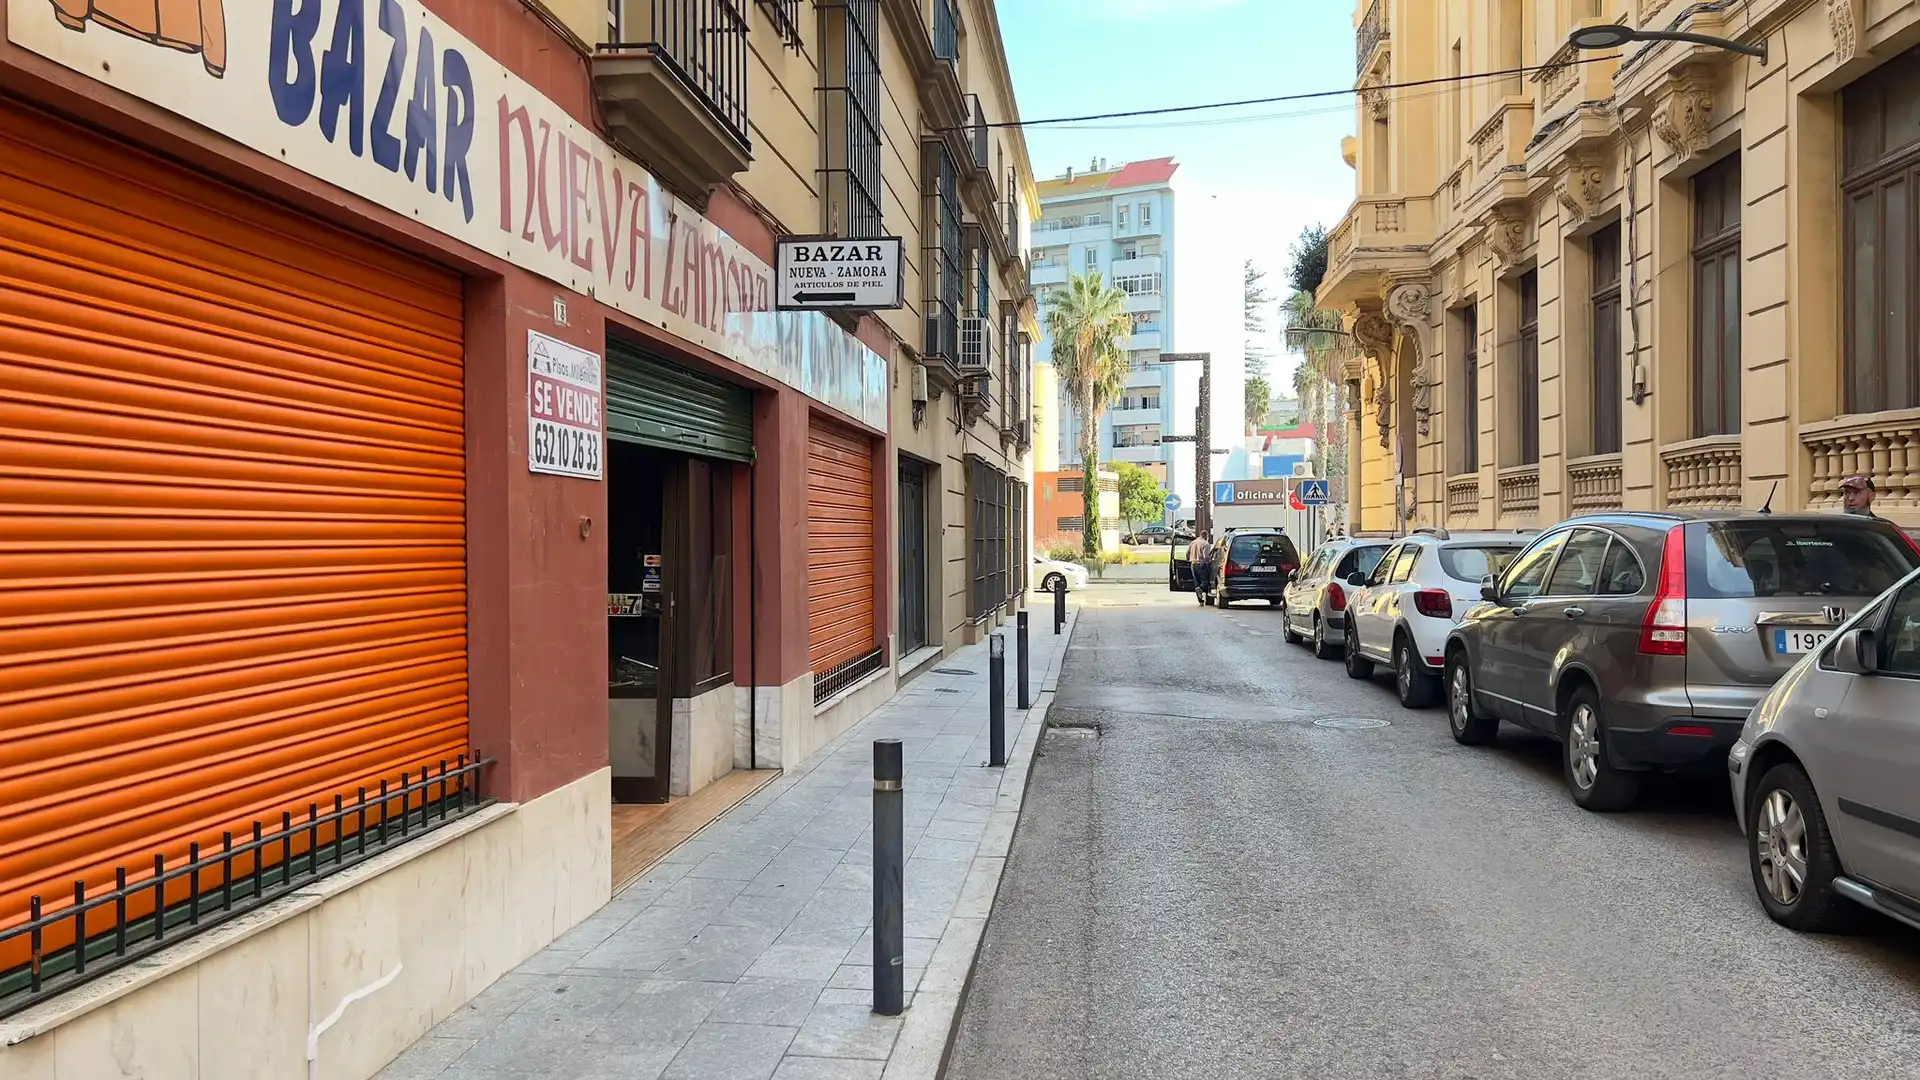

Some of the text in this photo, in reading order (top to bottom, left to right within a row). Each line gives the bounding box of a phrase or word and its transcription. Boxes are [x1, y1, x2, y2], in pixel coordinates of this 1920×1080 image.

[269, 0, 475, 224] BAZAR
[497, 93, 651, 300] NUEVA
[793, 246, 883, 262] BAZAR
[789, 266, 827, 278] NUEVA
[837, 266, 887, 278] ZAMORA
[794, 281, 844, 289] ARTICULOS
[862, 280, 884, 288] PIEL
[534, 379, 599, 427] SE VENDE
[535, 422, 598, 472] 632 10 26 33
[1237, 490, 1274, 500] Oficina
[1710, 625, 1755, 634] CR-V
